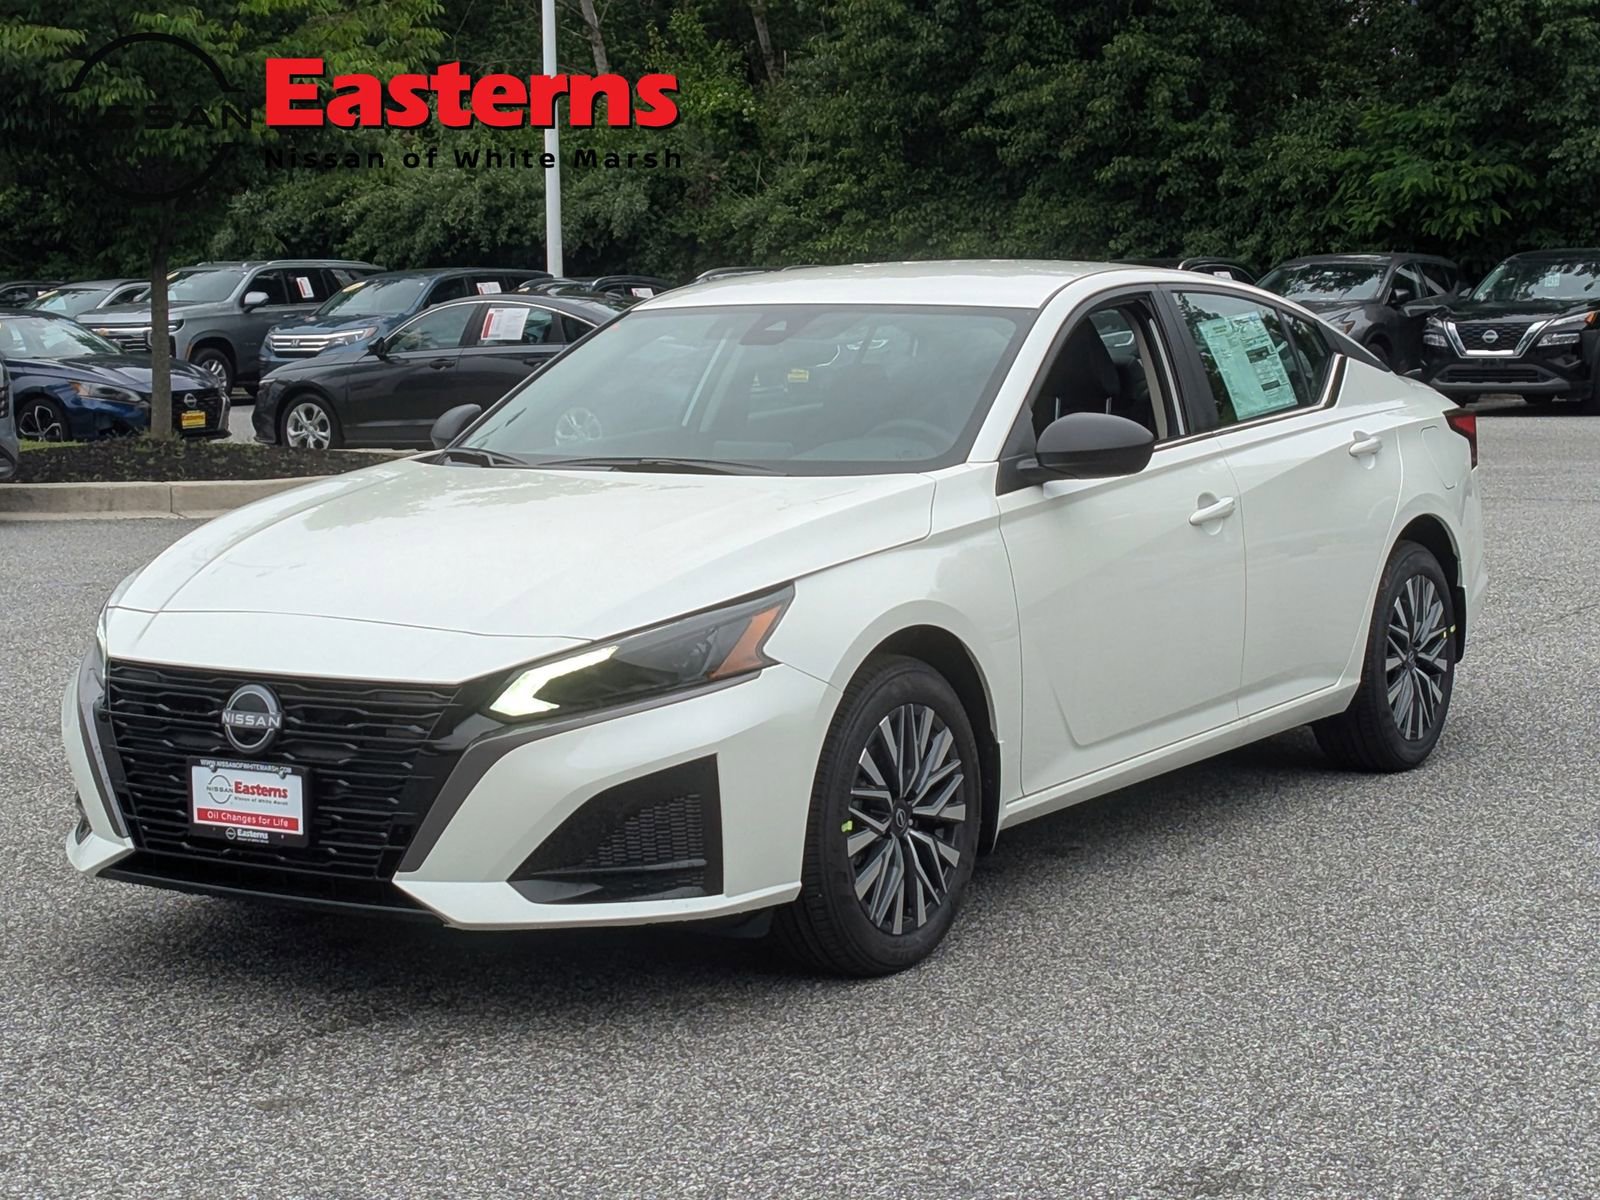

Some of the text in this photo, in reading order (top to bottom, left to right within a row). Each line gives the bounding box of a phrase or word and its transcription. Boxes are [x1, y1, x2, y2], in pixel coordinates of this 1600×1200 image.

[222, 711, 281, 728] NISSAN
[234, 781, 289, 799] Easterns
[207, 810, 289, 827] Oil Changes for Life
